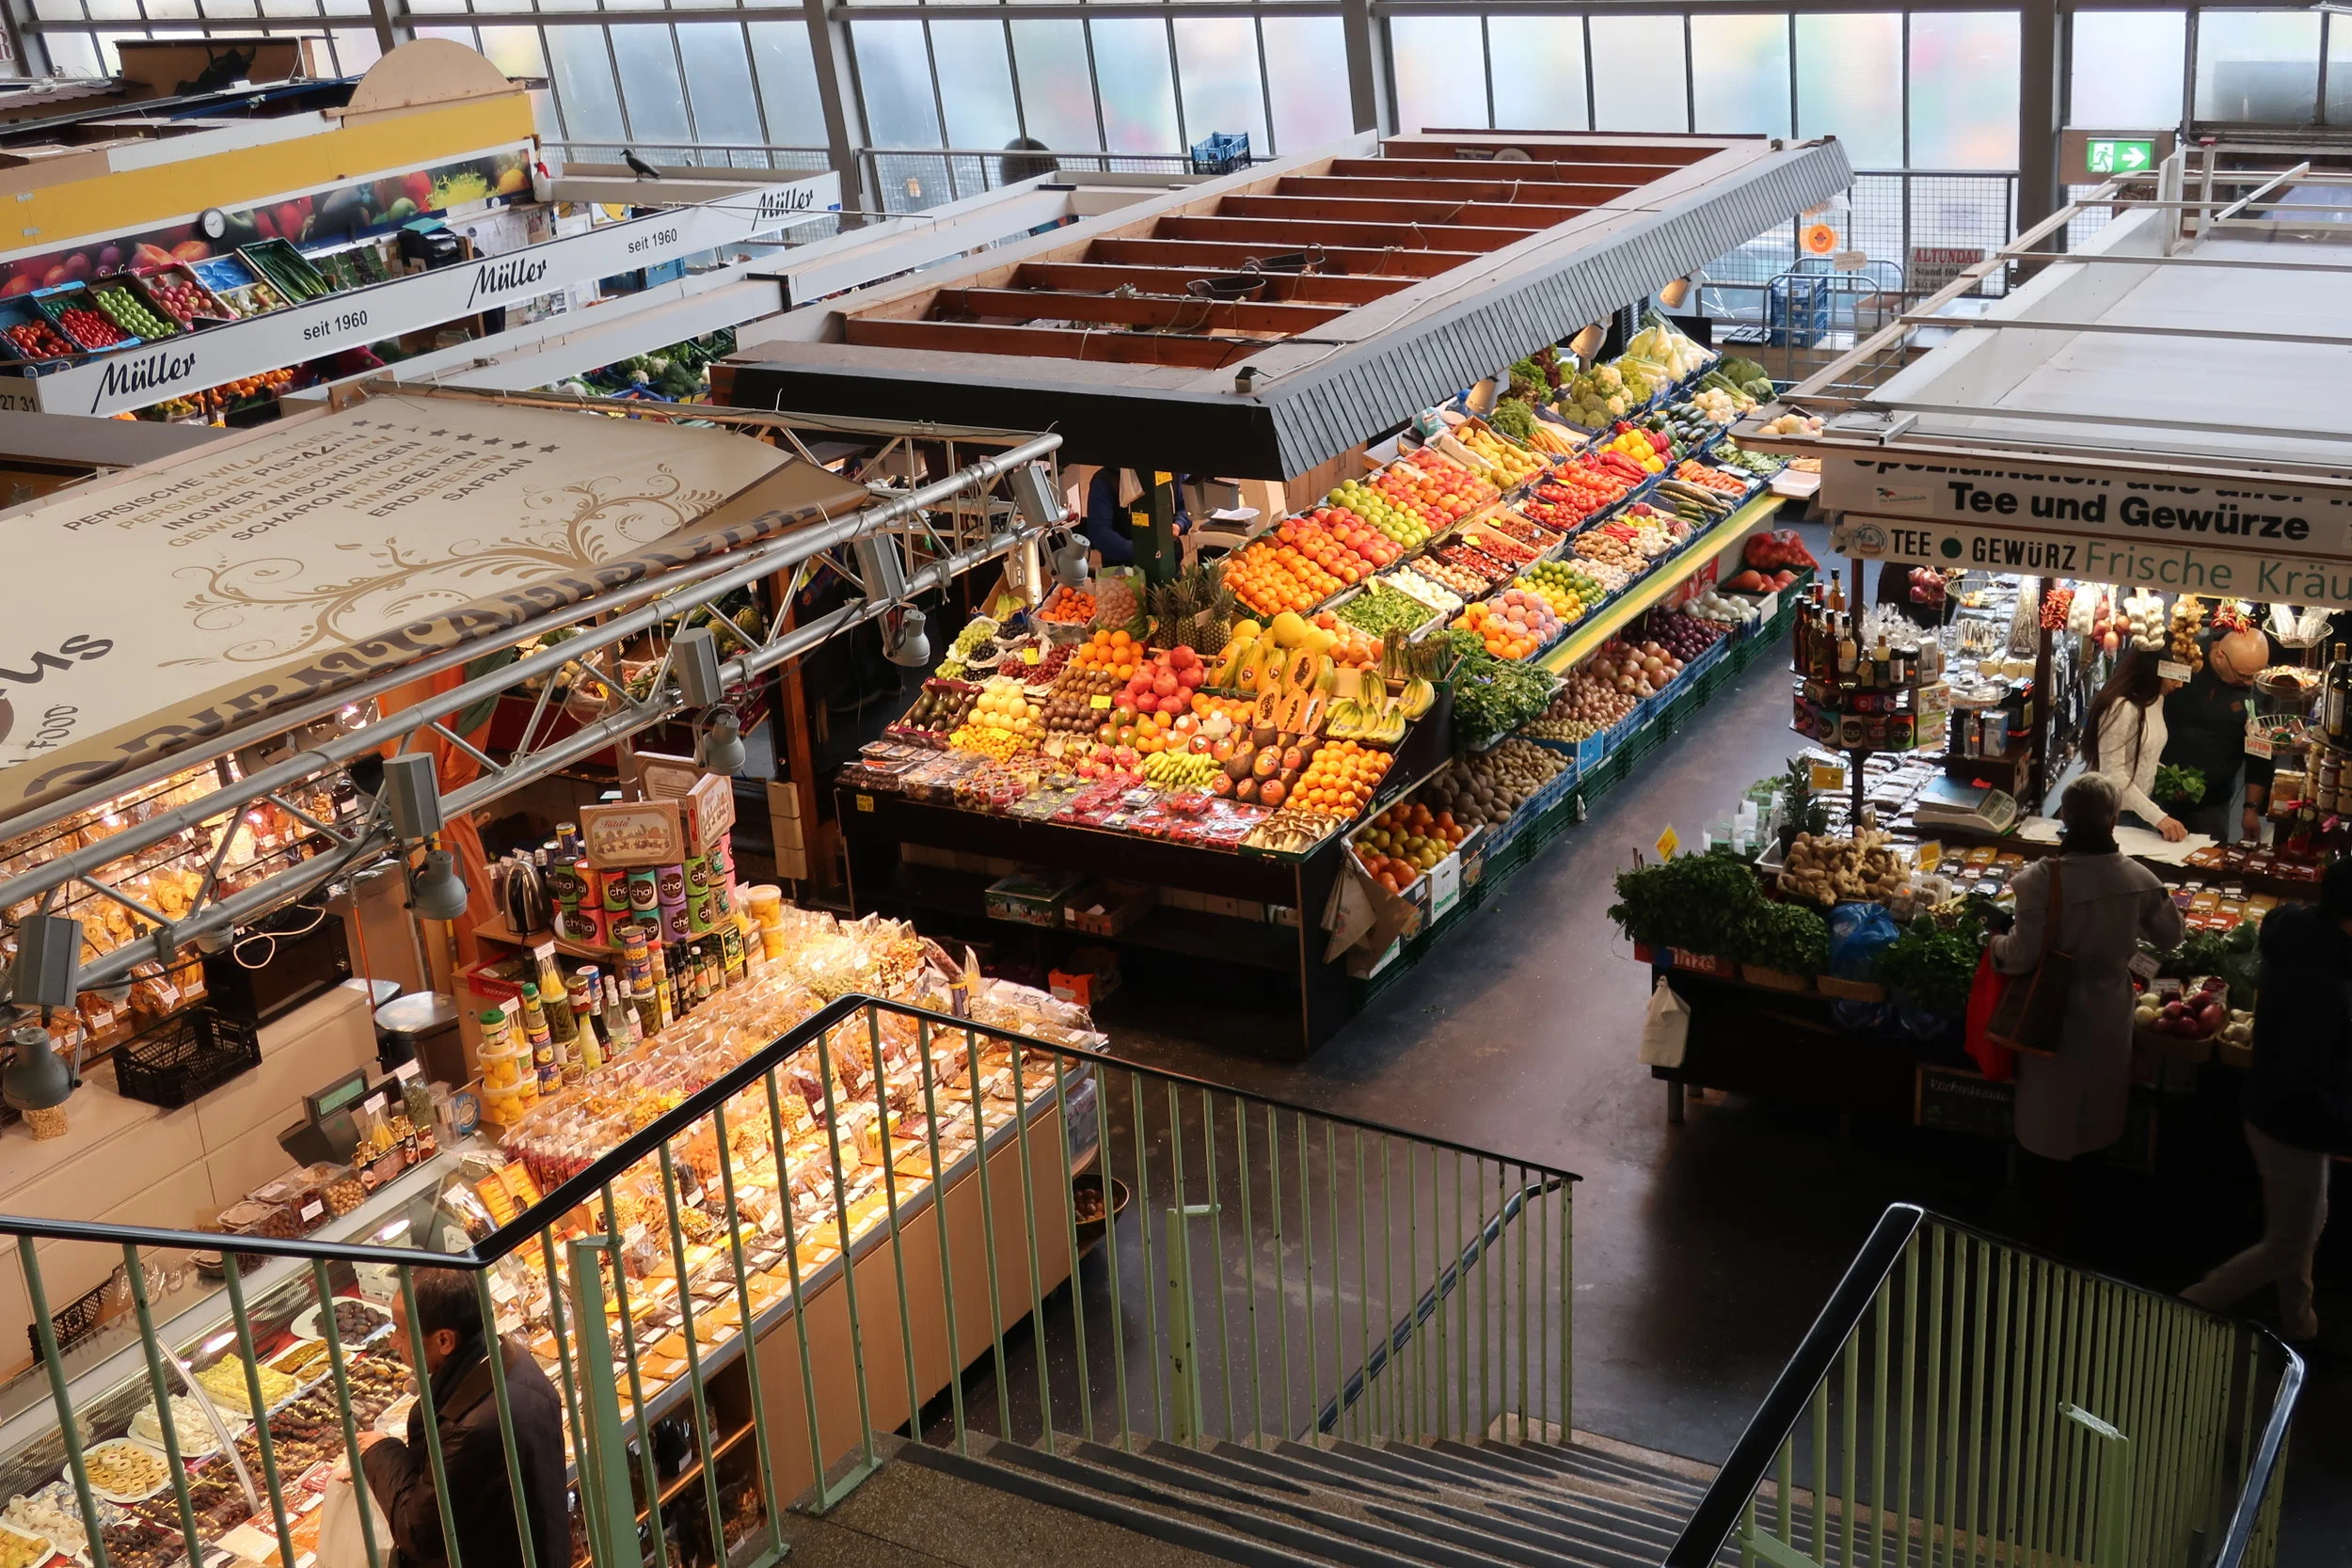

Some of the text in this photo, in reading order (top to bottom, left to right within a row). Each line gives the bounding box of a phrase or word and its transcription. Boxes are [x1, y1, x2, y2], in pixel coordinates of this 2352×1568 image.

[752, 187, 814, 232] Müller
[628, 228, 677, 254] seit 1960
[467, 258, 547, 309] Müller
[303, 309, 368, 341] seit 1960
[91, 352, 196, 415] Müller
[63, 478, 204, 531] PERSISCHE
[117, 476, 256, 530] PERSISCHE
[161, 436, 395, 530] INGWER TEESORTEN
[167, 441, 422, 547] GEWÜRZMISCHUNGEN
[343, 451, 477, 509] HIMBEEREN
[367, 454, 504, 517] ERDBEEREN
[441, 458, 533, 501] SAFRAN
[1948, 481, 2018, 514] Tee
[2031, 494, 2107, 523] und
[2120, 496, 2310, 541] Gewürze
[1891, 529, 1931, 557] TEE
[2085, 541, 2233, 590] Frische
[631, 886, 653, 897] chai
[661, 880, 683, 891] chai
